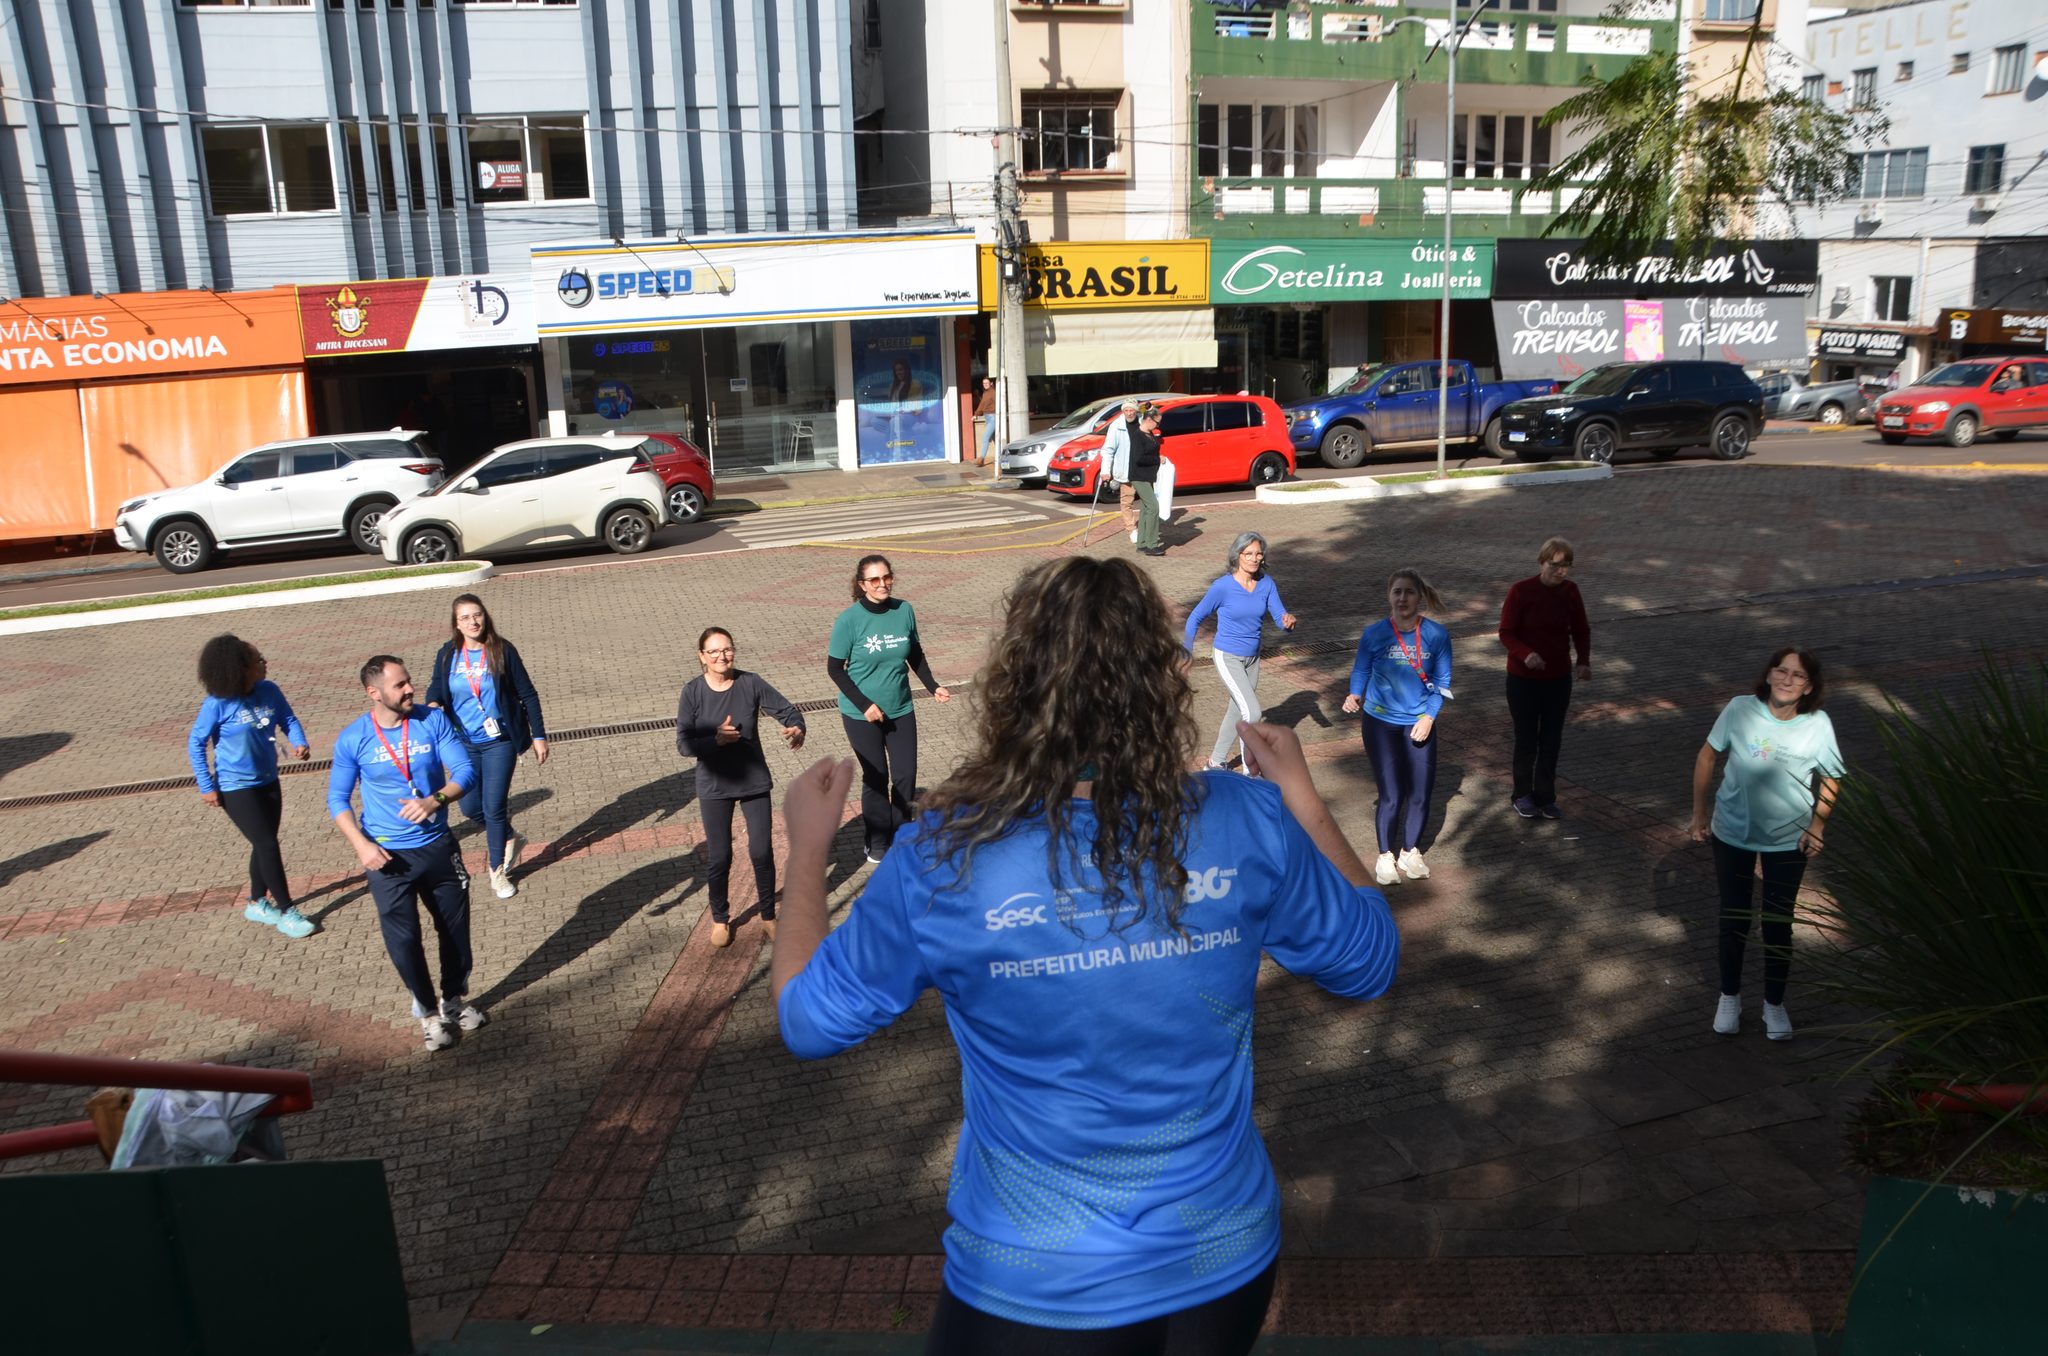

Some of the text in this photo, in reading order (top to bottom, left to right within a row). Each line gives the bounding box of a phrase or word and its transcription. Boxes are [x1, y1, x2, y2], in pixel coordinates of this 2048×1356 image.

[497, 164, 521, 174] ALUGA
[1461, 246, 1477, 262] &
[597, 269, 692, 297] SPEED
[1022, 265, 1178, 302] BRASIL
[1221, 245, 1383, 295] Getelina
[1517, 300, 1608, 330] Calçados
[1512, 328, 1620, 355] TREVISOL
[1678, 319, 1780, 346] TREVISOL
[1820, 331, 1858, 347] FOTO
[1950, 319, 1968, 340] B
[63, 335, 228, 367] ECONOMIA
[316, 338, 388, 350] MITRA DIOCESANA
[611, 341, 653, 354] SPEED
[1183, 866, 1231, 904] 80
[989, 927, 1242, 978] PREFEITURA MUNICIPAL
